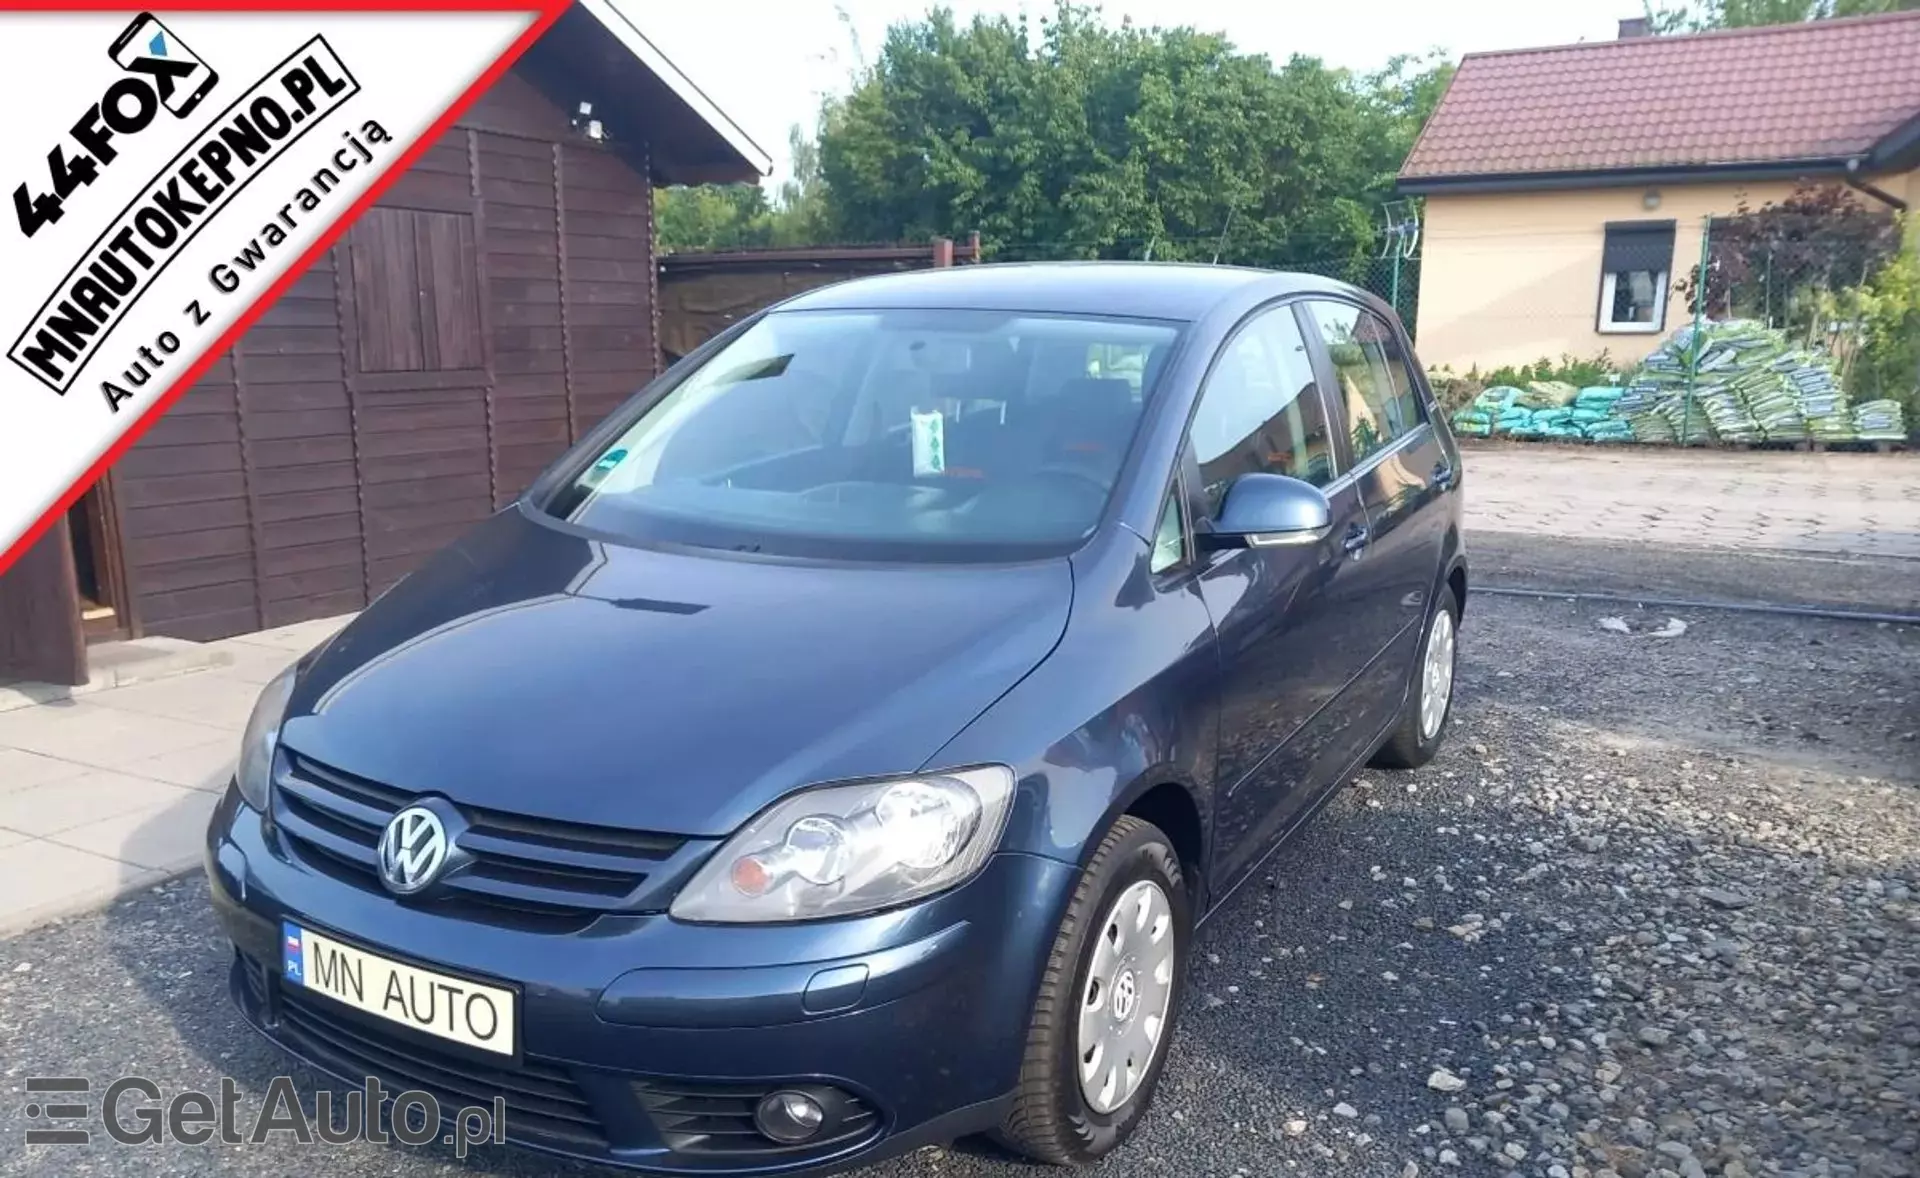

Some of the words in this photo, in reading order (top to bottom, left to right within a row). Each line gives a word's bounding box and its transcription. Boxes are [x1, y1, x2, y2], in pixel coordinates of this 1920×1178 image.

[287, 959, 302, 977] PL
[313, 941, 364, 1003] MN
[382, 969, 498, 1041] AUTO
